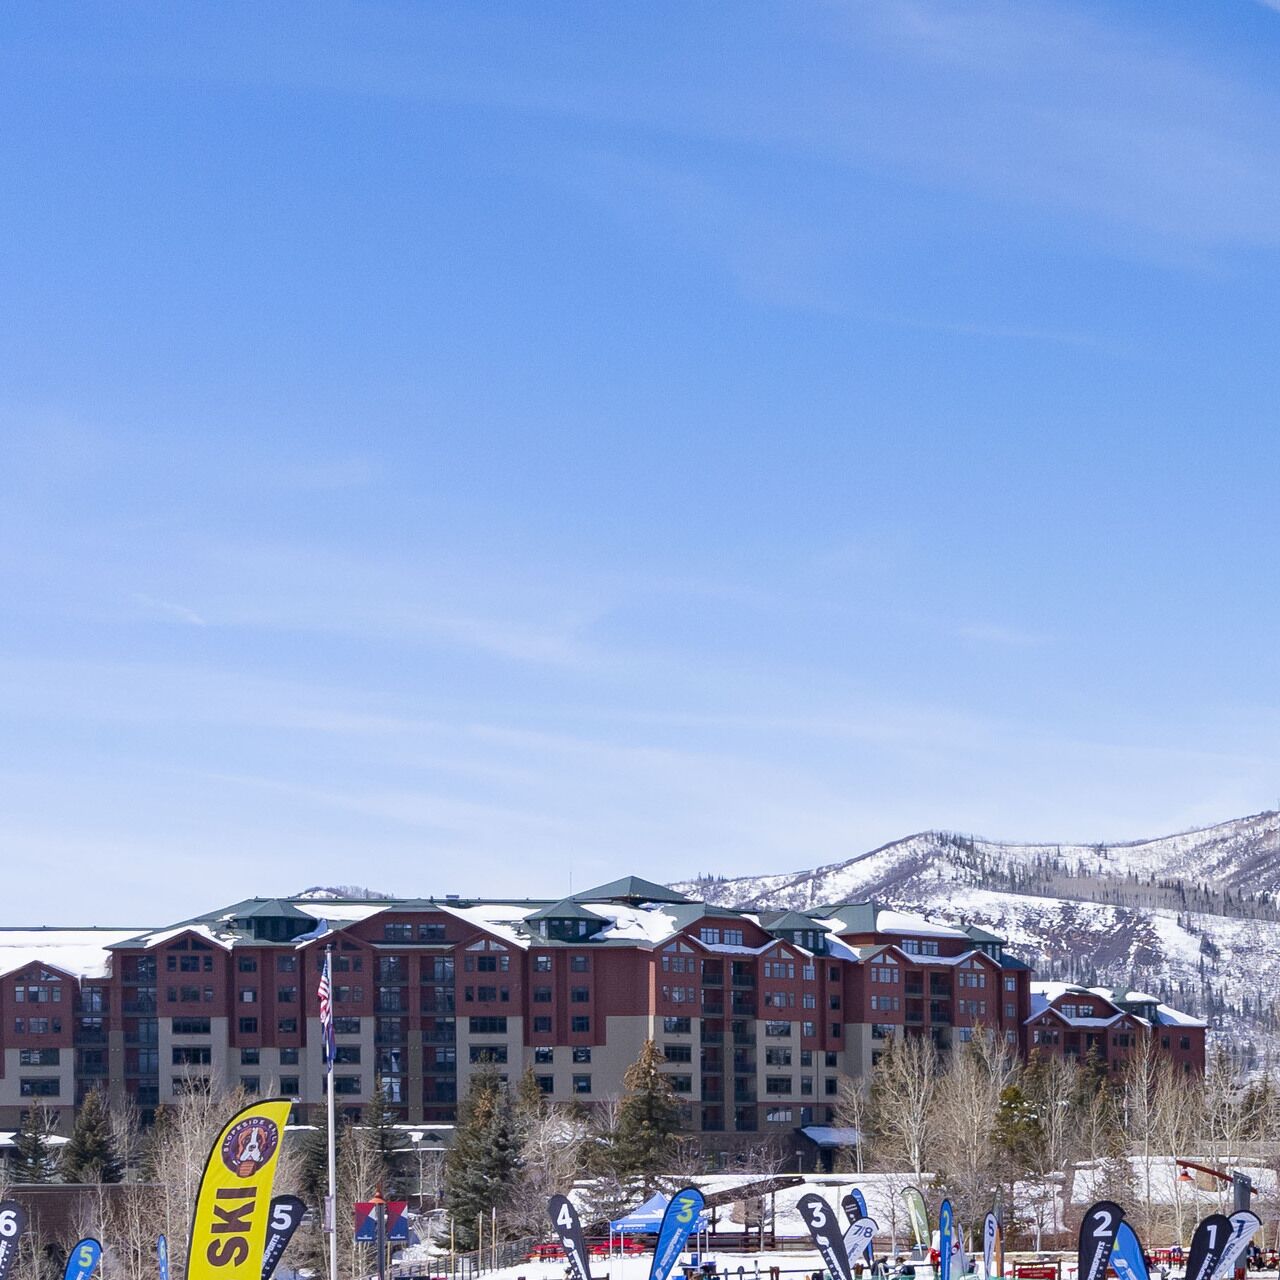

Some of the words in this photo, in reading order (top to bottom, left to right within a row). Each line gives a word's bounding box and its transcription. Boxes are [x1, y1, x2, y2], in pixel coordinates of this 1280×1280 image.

[271, 1205, 292, 1230] 5
[557, 1204, 573, 1229] 4
[677, 1198, 695, 1223] 3
[808, 1202, 826, 1228] 3
[943, 1210, 950, 1236] 2
[0, 1210, 17, 1237] 6
[207, 1186, 257, 1267] SKI
[852, 1225, 873, 1238] 7/8
[988, 1220, 995, 1237] 5
[1093, 1211, 1112, 1237] 2
[1236, 1220, 1246, 1238] 7
[1207, 1224, 1217, 1249] 1
[78, 1246, 93, 1267] 5
